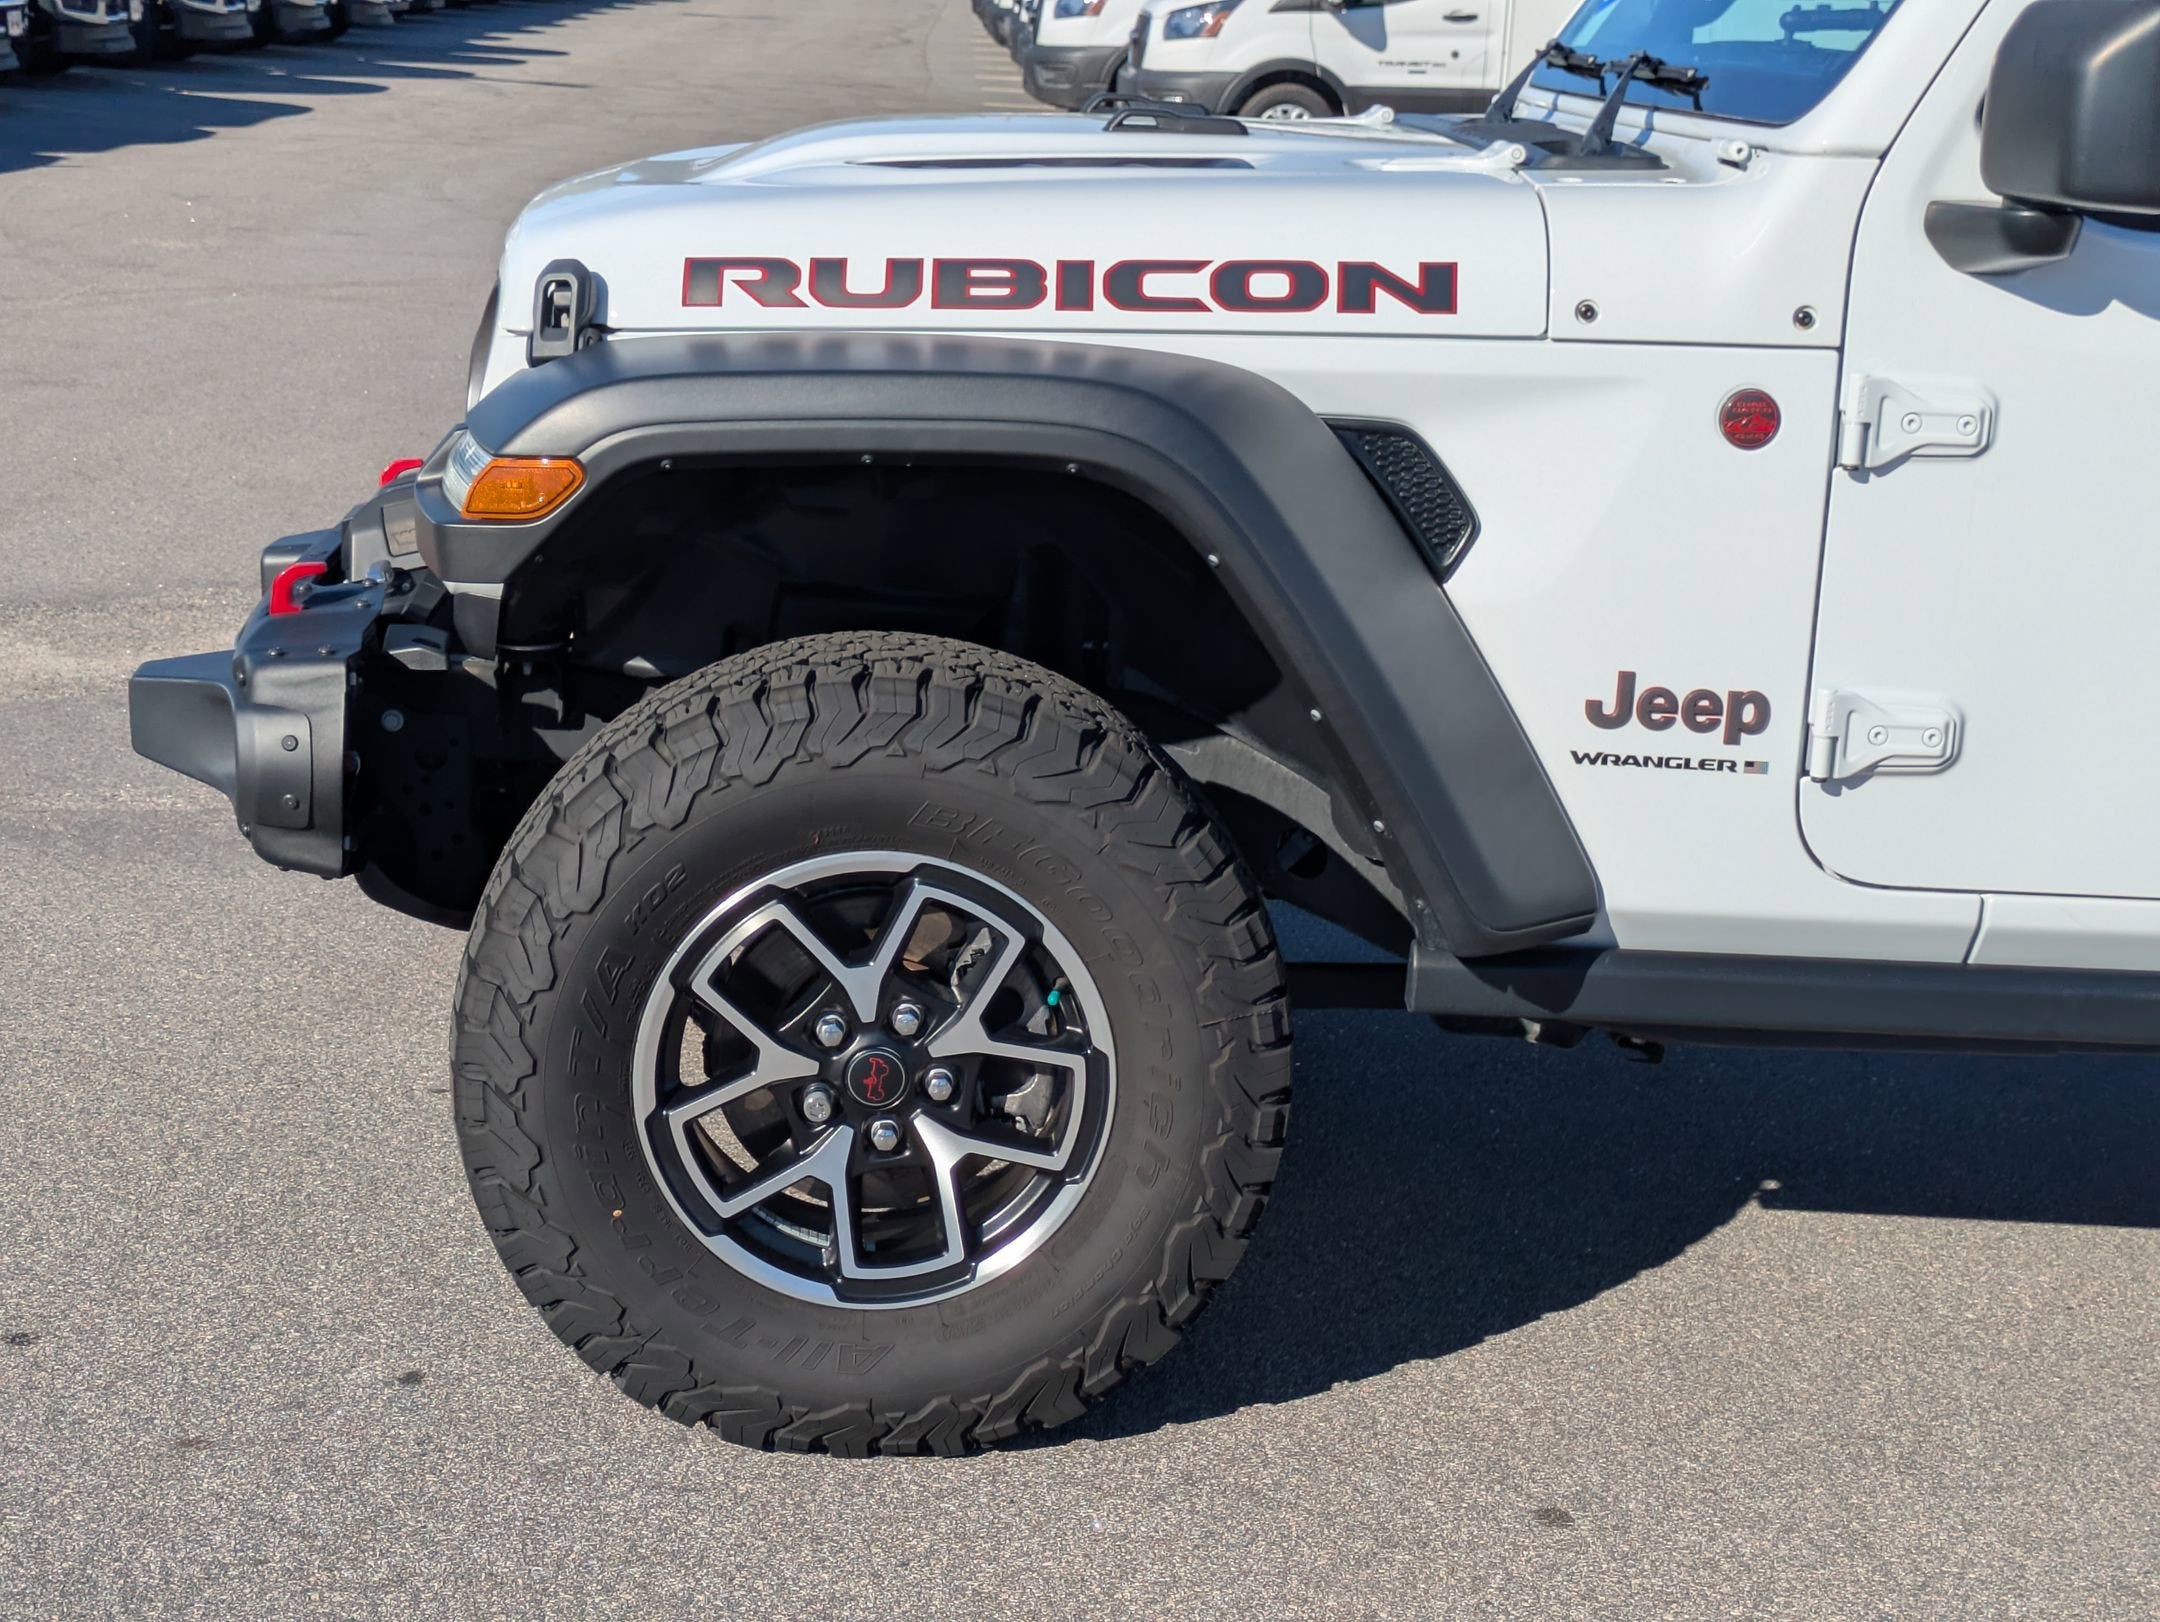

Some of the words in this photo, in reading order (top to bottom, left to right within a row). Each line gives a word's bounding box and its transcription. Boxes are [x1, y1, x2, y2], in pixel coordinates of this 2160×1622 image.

[681, 256, 1459, 315] RUBICON
[1585, 670, 1771, 746] Jeep
[1569, 750, 1738, 773] WRANGLER
[567, 945, 636, 1076] T/A
